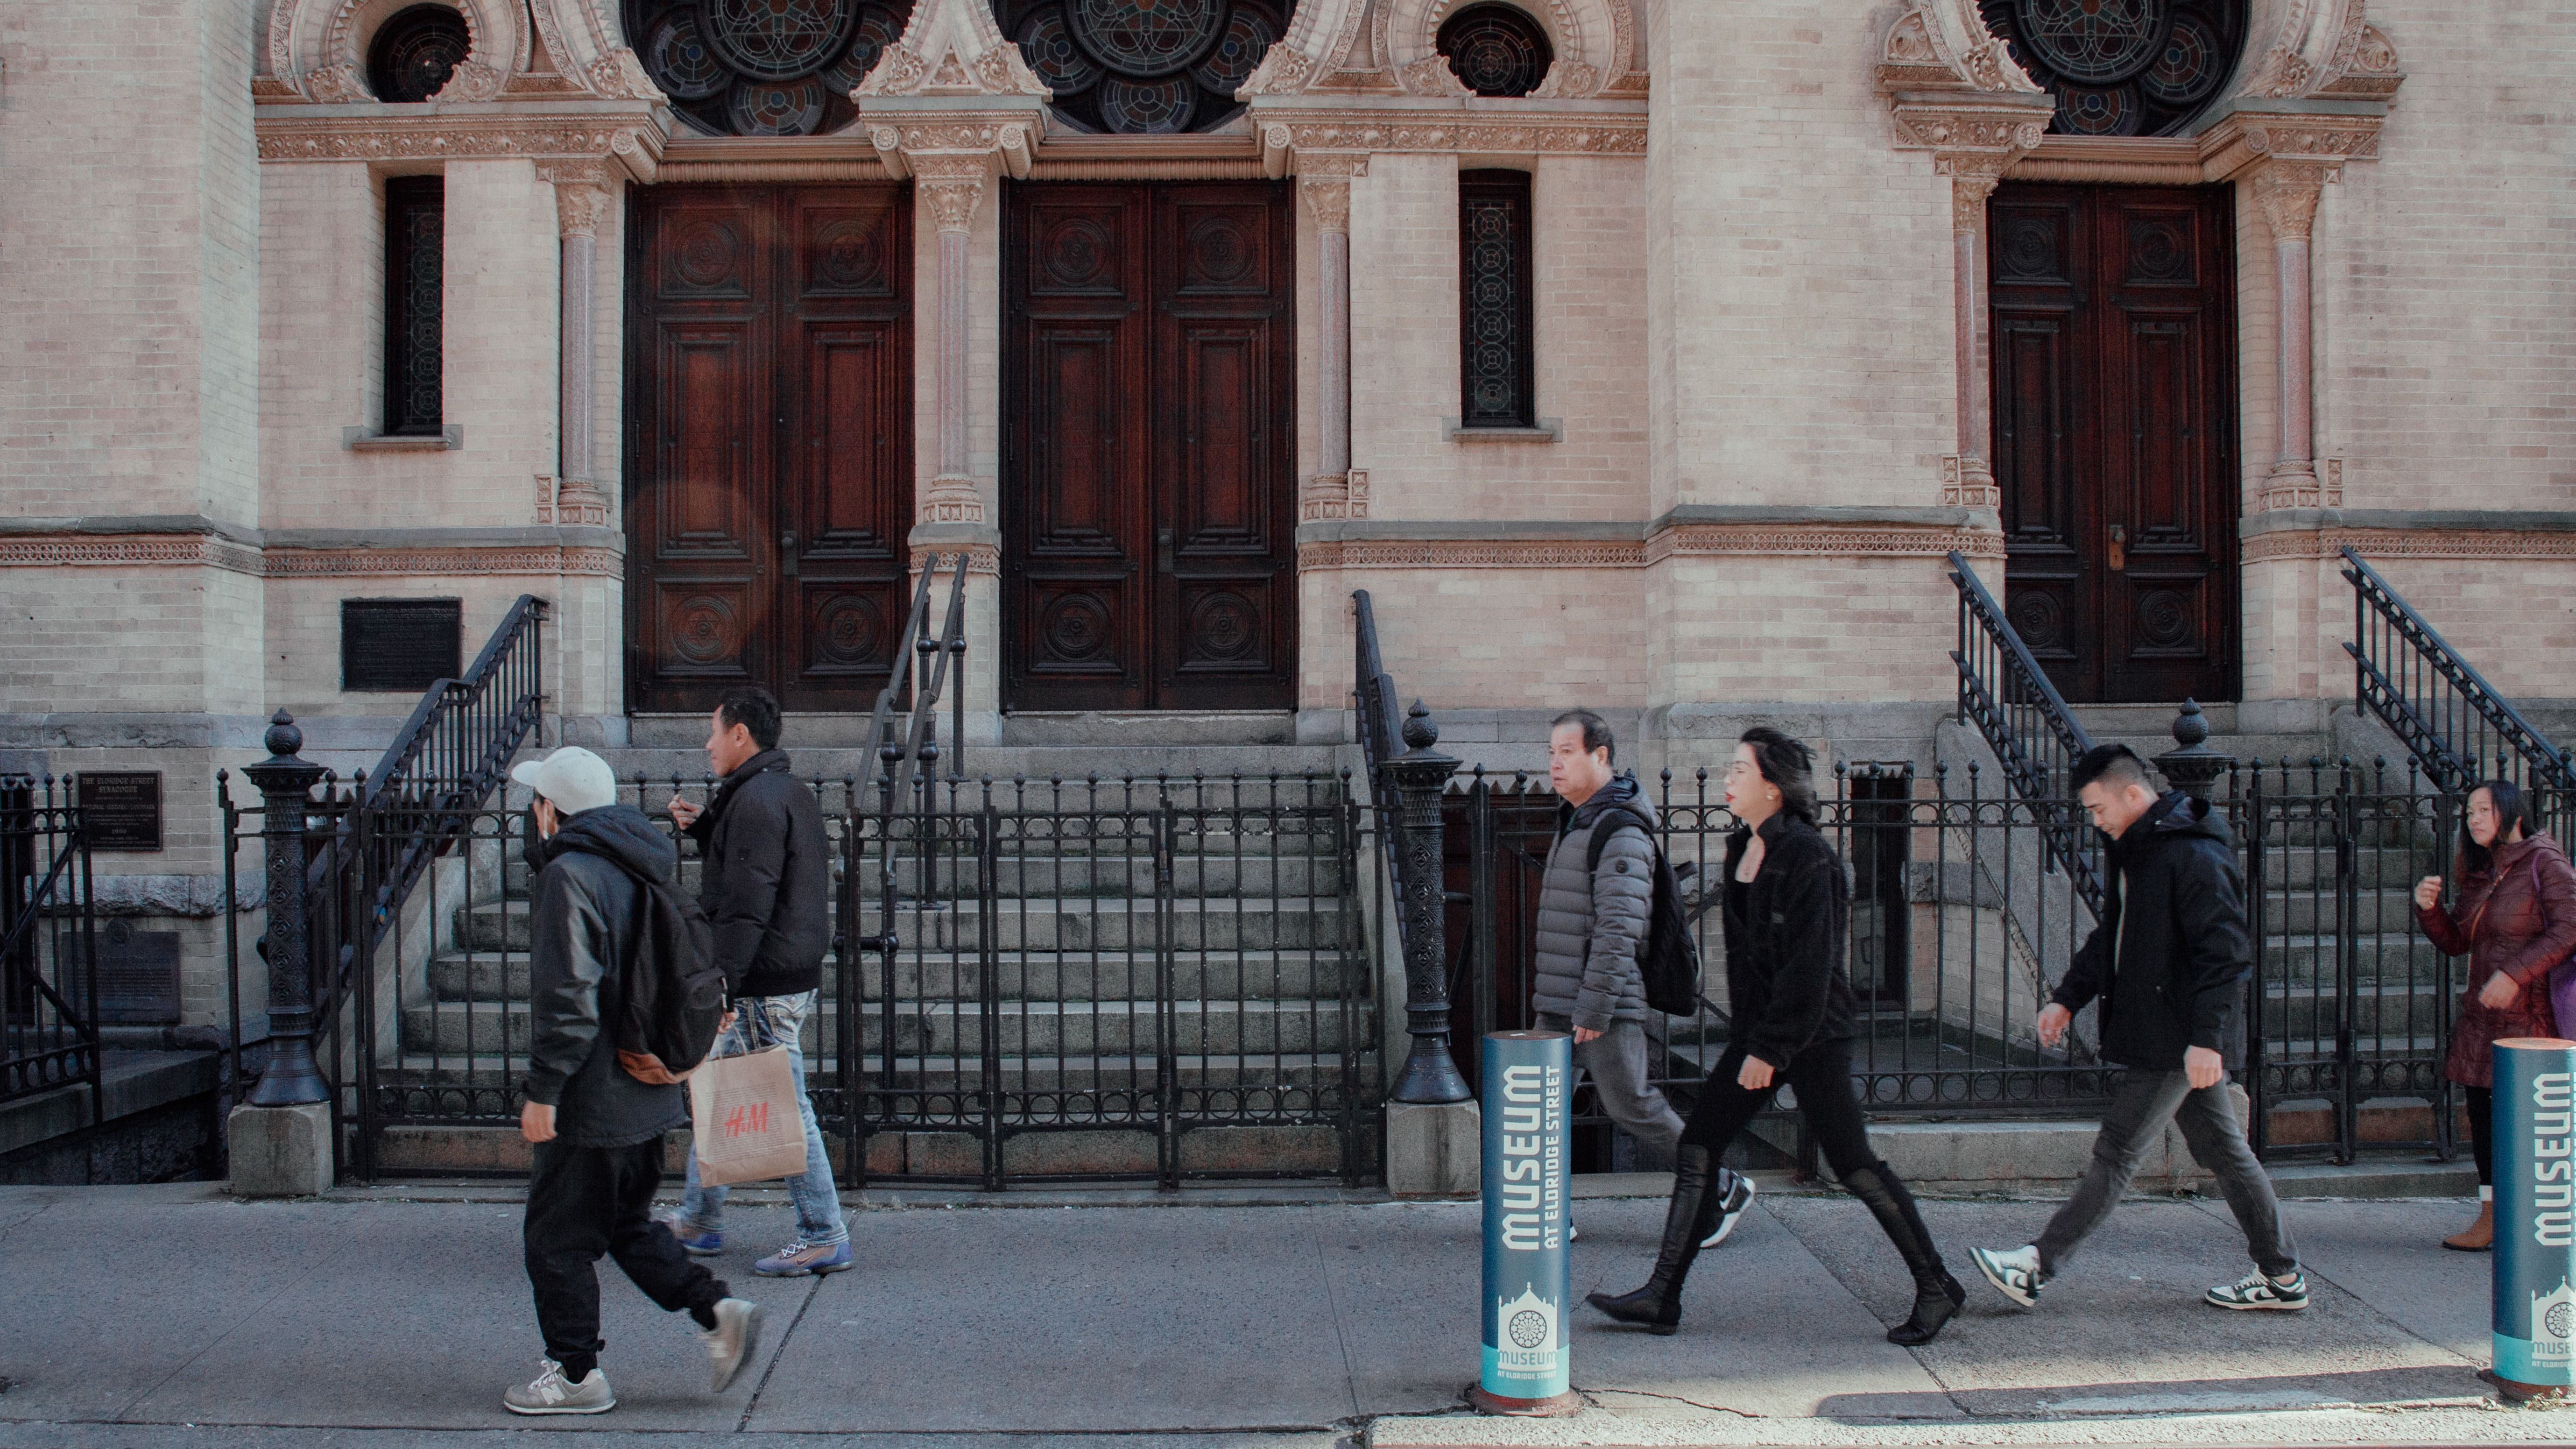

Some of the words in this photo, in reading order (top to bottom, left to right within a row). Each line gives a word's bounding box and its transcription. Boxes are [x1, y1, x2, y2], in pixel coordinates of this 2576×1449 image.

[1546, 1065, 1560, 1131] STREET
[724, 1101, 768, 1138] H&M
[1502, 1065, 1541, 1250] MUSEUM
[2533, 1073, 2572, 1246] MUSEUM
[1545, 1135, 1559, 1221] ELDRIDGE
[1544, 1226, 1558, 1249] AT
[1498, 1350, 1557, 1365] MUSEUM
[1506, 1371, 1536, 1379] ELDRIDGE
[540, 1383, 565, 1405] N
